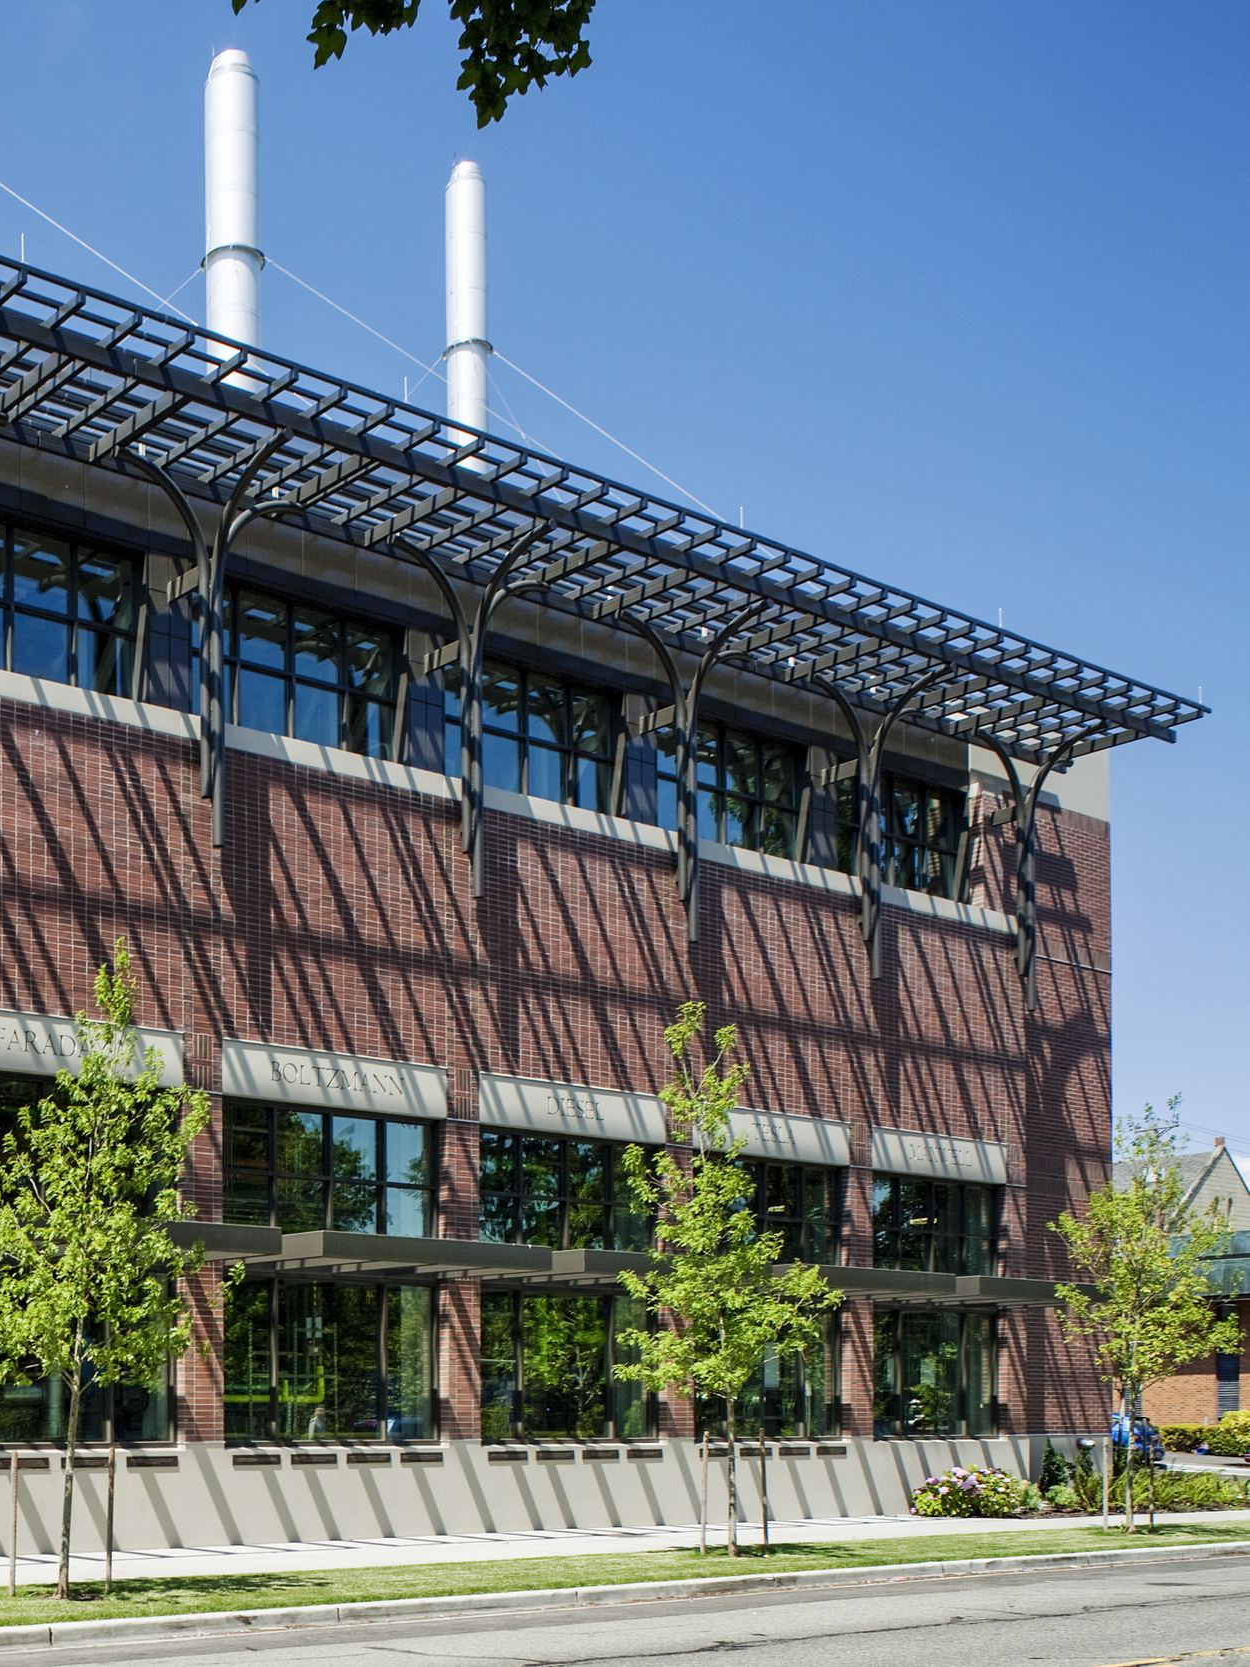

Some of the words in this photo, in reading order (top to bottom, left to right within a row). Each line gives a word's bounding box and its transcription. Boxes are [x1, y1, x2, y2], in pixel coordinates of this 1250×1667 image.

[270, 1060, 405, 1096] BOLTZMANN
[547, 1096, 605, 1121] DIESEL
[751, 1122, 796, 1146] TESLA
[909, 1143, 973, 1167] MAXWELL
